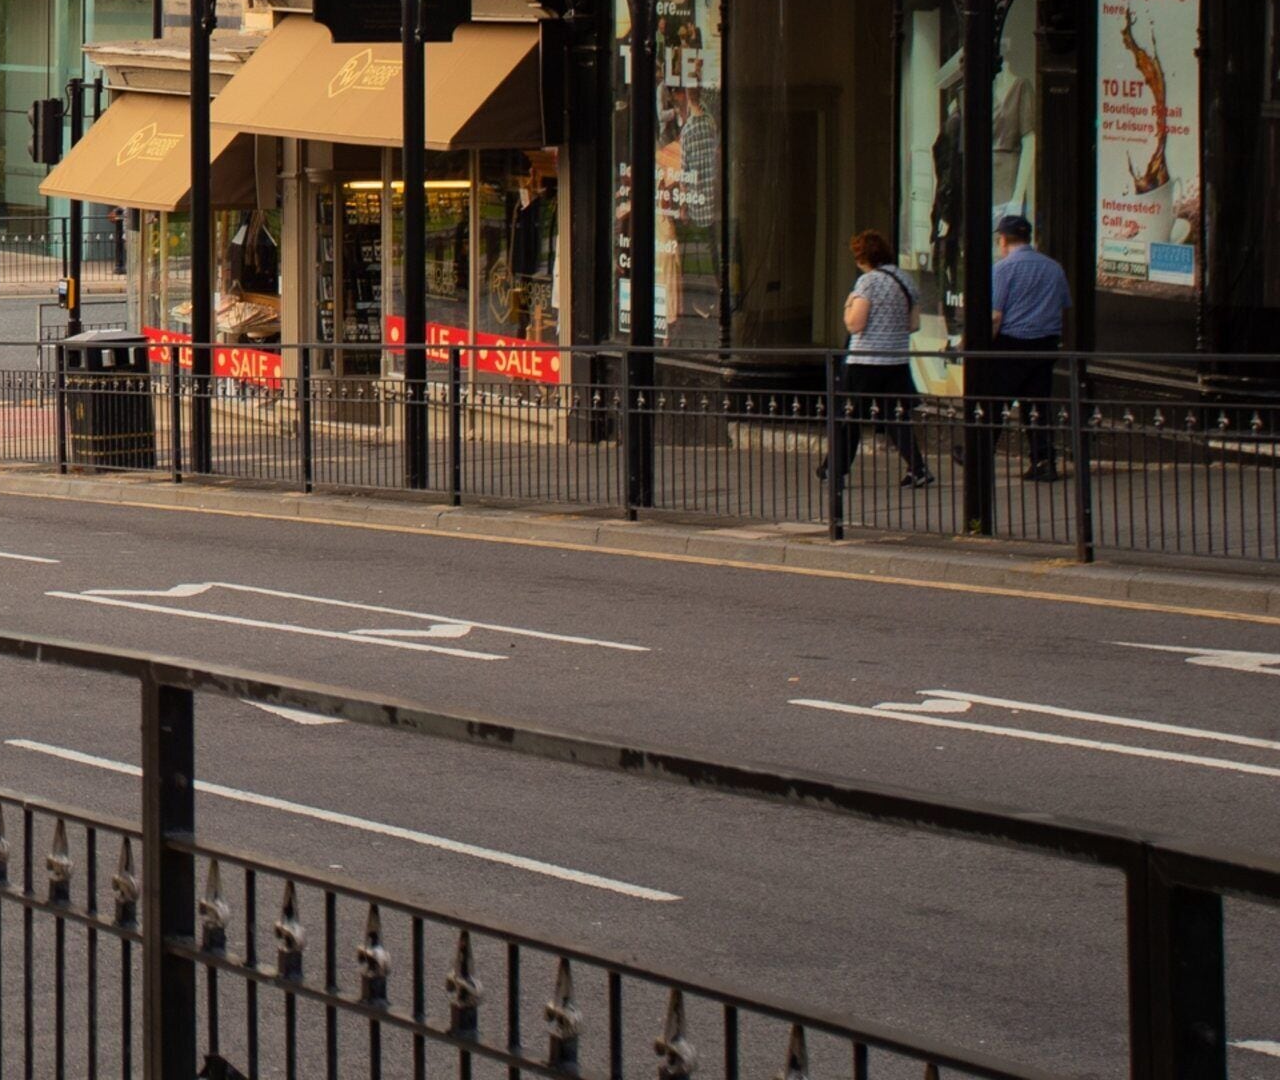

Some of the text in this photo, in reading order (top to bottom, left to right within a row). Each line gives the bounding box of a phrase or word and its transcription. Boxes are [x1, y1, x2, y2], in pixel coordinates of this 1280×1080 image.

[1103, 79, 1144, 98] TO LET
[1103, 102, 1149, 118] Boutique
[1102, 120, 1114, 131] or
[1115, 119, 1154, 134] Leisure
[672, 188, 706, 206] Space
[1102, 199, 1162, 215] Interested?
[1102, 215, 1122, 227] Call
[231, 349, 270, 383] SALE
[494, 338, 543, 378] SALE
